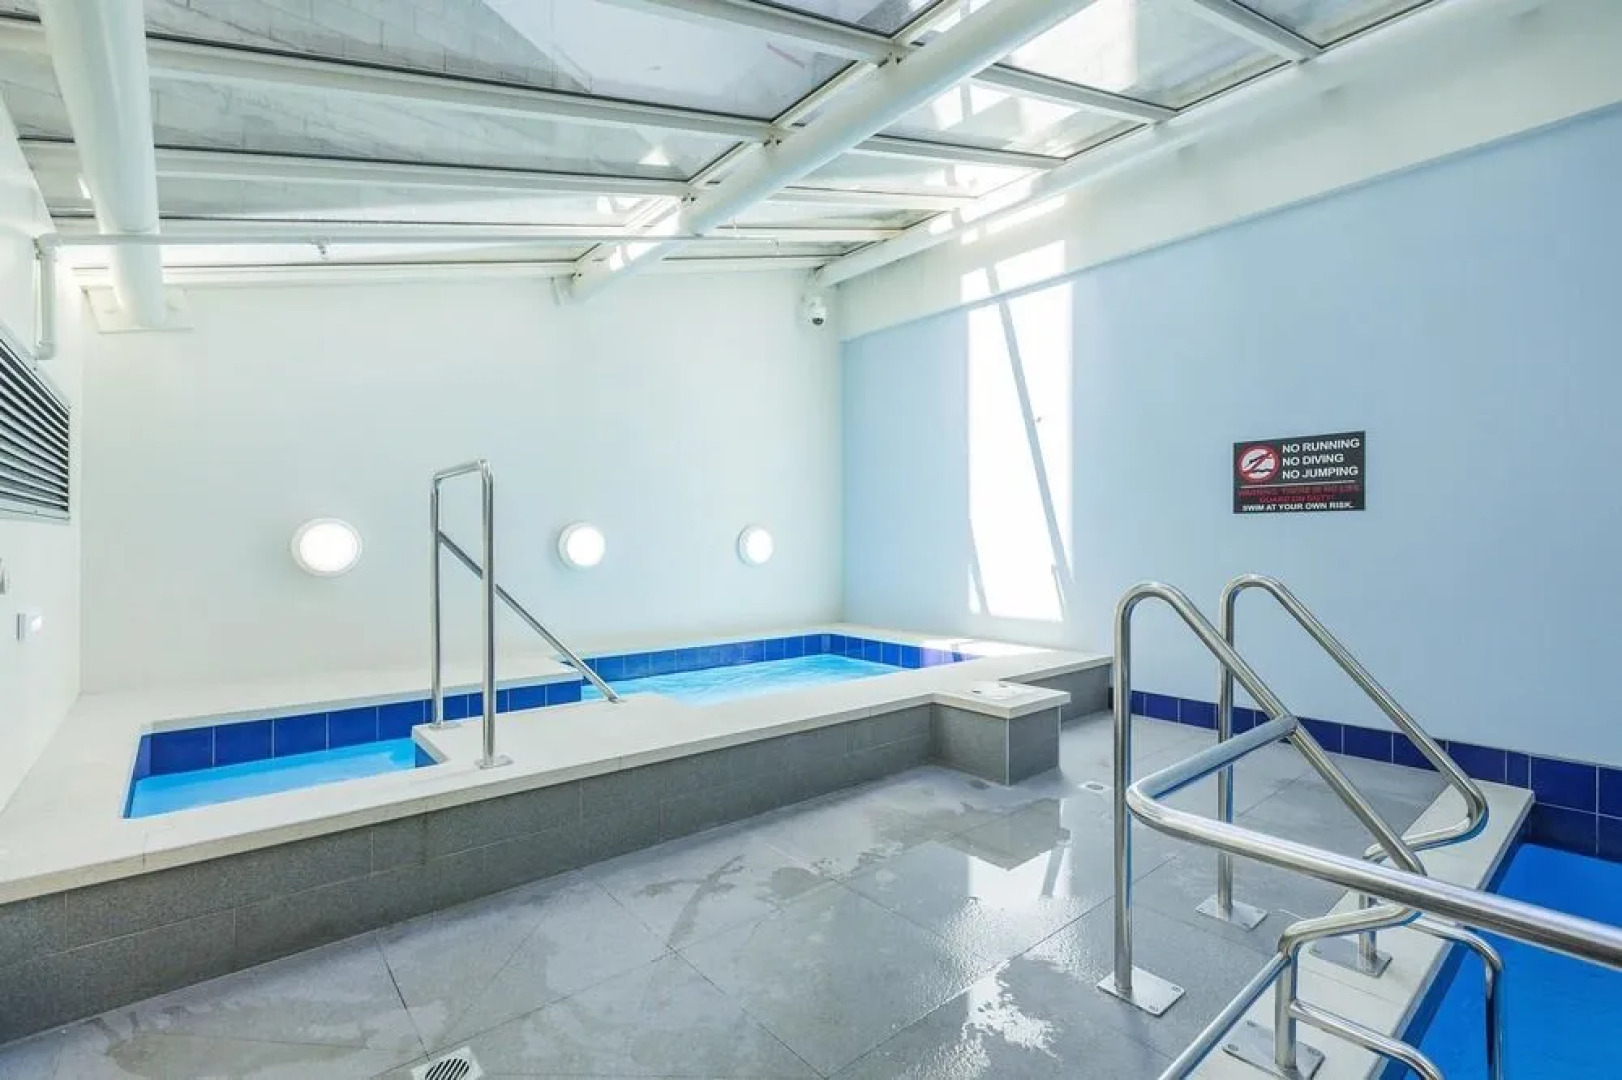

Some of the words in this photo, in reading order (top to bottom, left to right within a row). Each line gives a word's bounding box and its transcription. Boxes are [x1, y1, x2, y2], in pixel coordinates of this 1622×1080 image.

[1282, 443, 1300, 453] NO
[1302, 438, 1360, 452] RUNNING
[1282, 456, 1300, 466] NO
[1302, 453, 1344, 465] DIVING
[1282, 469, 1300, 480] NO
[1302, 465, 1359, 478] JUMPING
[1279, 503, 1303, 511] YOUR
[1305, 502, 1328, 510] OWN
